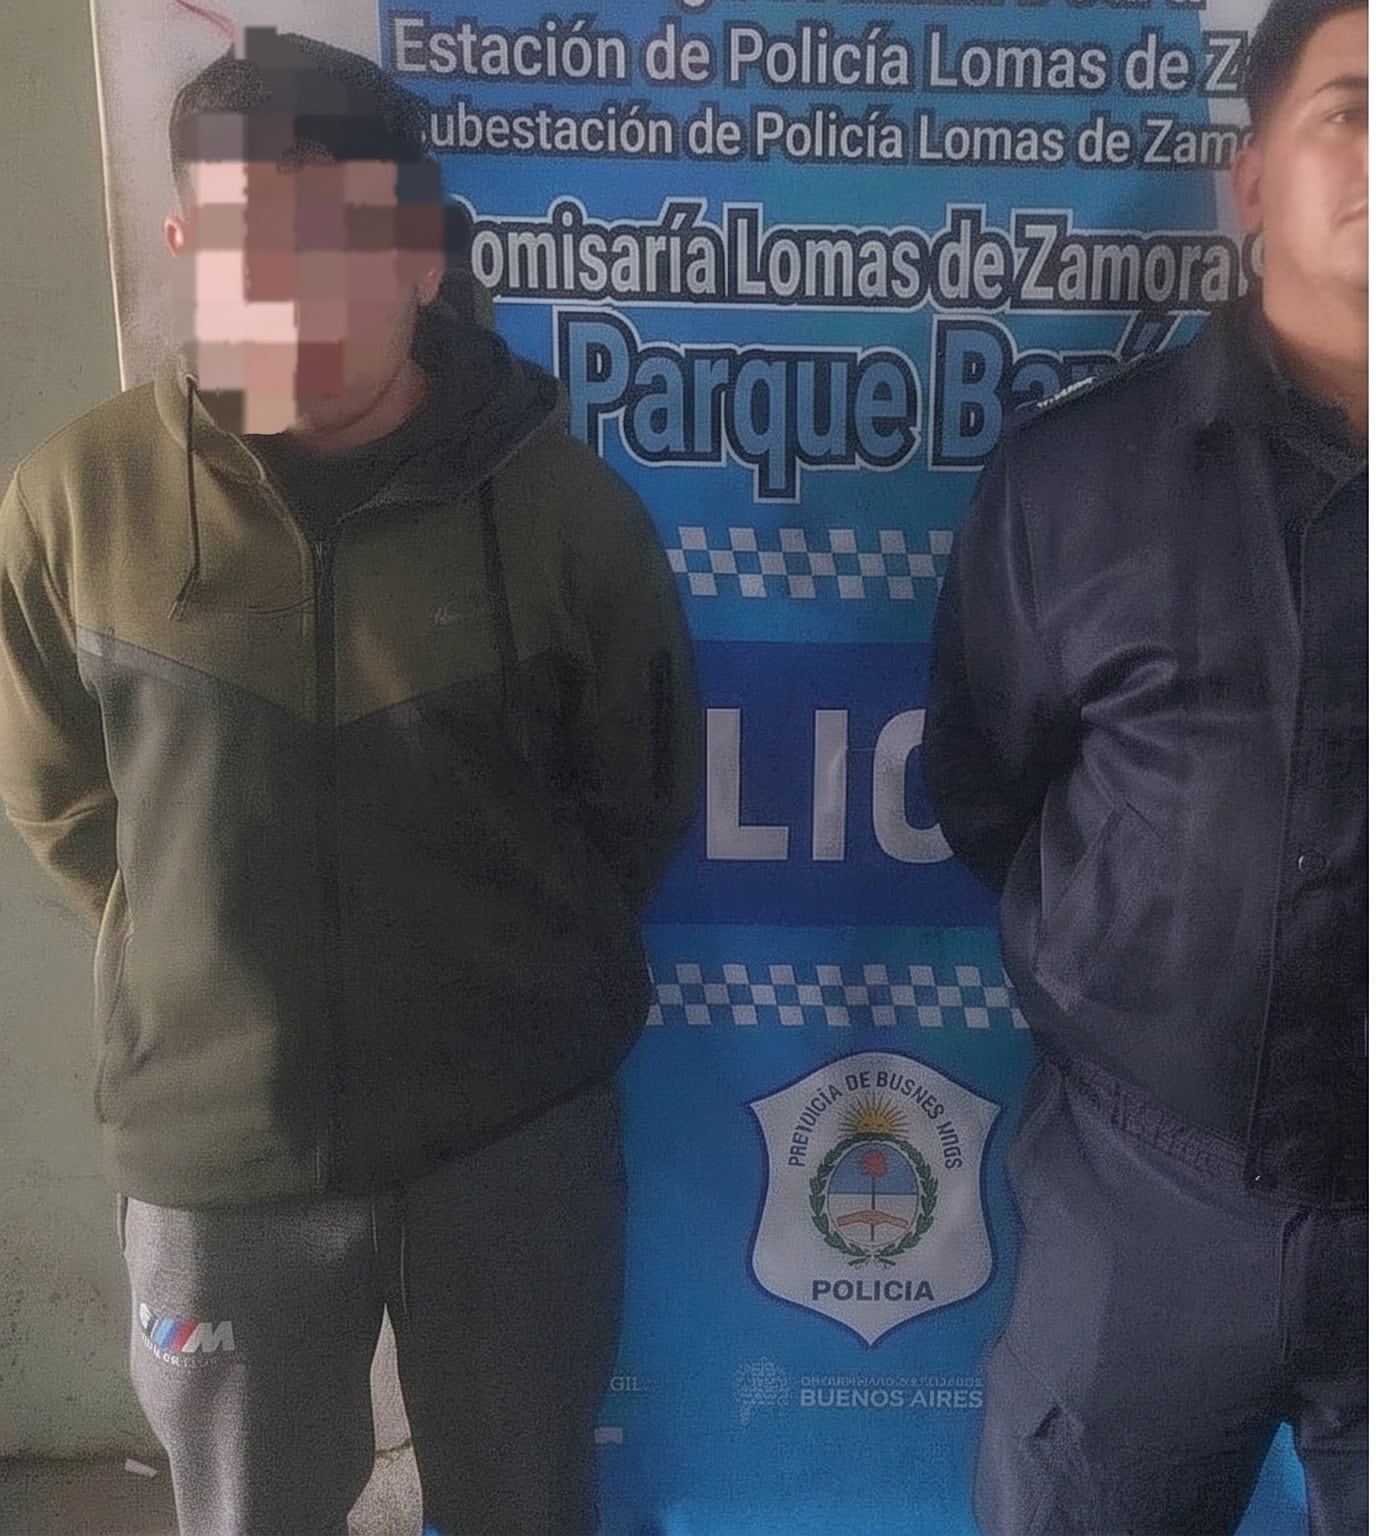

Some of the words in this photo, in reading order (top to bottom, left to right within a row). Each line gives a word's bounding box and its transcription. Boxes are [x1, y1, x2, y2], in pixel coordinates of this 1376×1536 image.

[395, 18, 625, 79] Estación
[645, 24, 711, 82] de
[730, 26, 909, 87] Policía
[930, 31, 1107, 91] Lomas
[1124, 32, 1188, 91] de
[422, 102, 672, 154] ubestación
[688, 108, 741, 156] de
[757, 110, 902, 160] Policía
[920, 114, 1065, 164] Lomas
[1078, 117, 1131, 164] de
[471, 210, 716, 295] omisaría
[737, 217, 920, 297] Lomas
[938, 219, 1004, 300] de
[1020, 224, 1232, 302] Zamora
[568, 322, 905, 490] Parque
[845, 1071, 871, 1091] DE
[812, 1280, 934, 1301] POLICIA
[800, 1388, 904, 1407] BUENOS
[909, 1389, 984, 1408] AIRES
